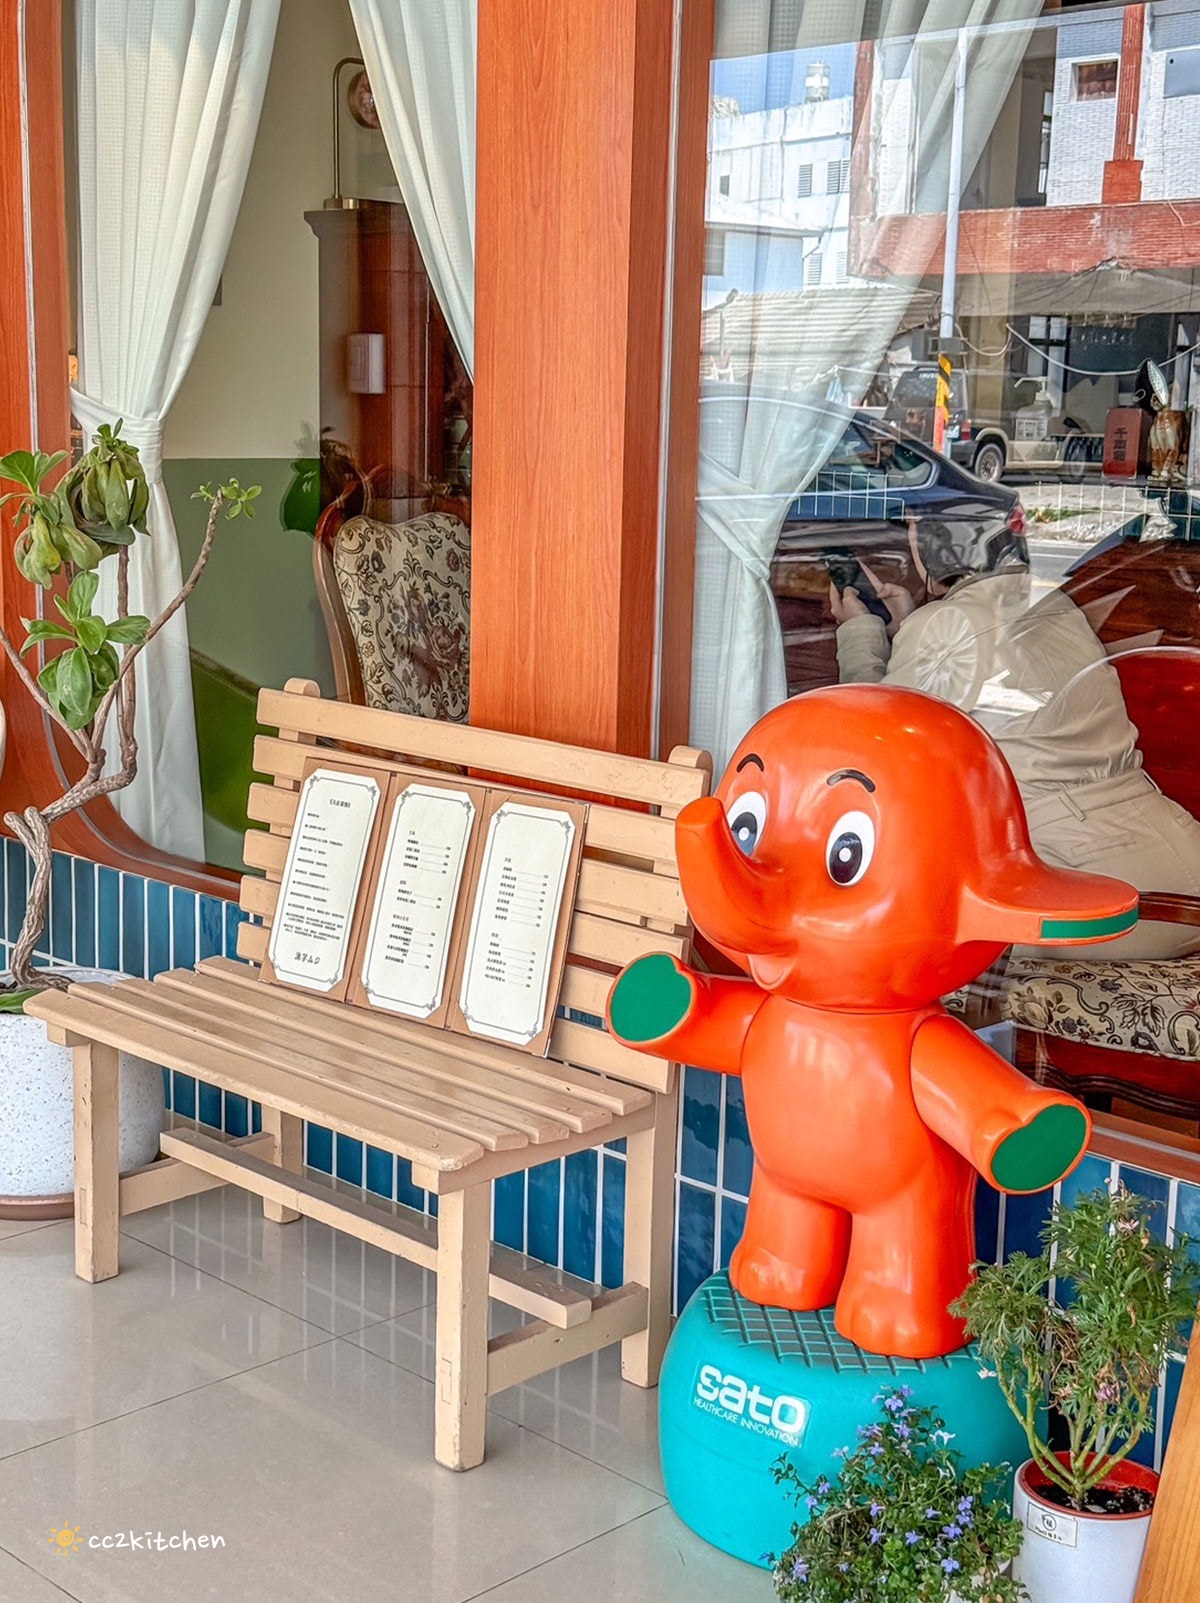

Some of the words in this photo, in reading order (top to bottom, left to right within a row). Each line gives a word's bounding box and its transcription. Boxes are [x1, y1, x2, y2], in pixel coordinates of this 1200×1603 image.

[693, 1397, 739, 1424] HEALTHCARE
[740, 1418, 799, 1447] INNOVATION
[697, 1364, 806, 1434] sato
